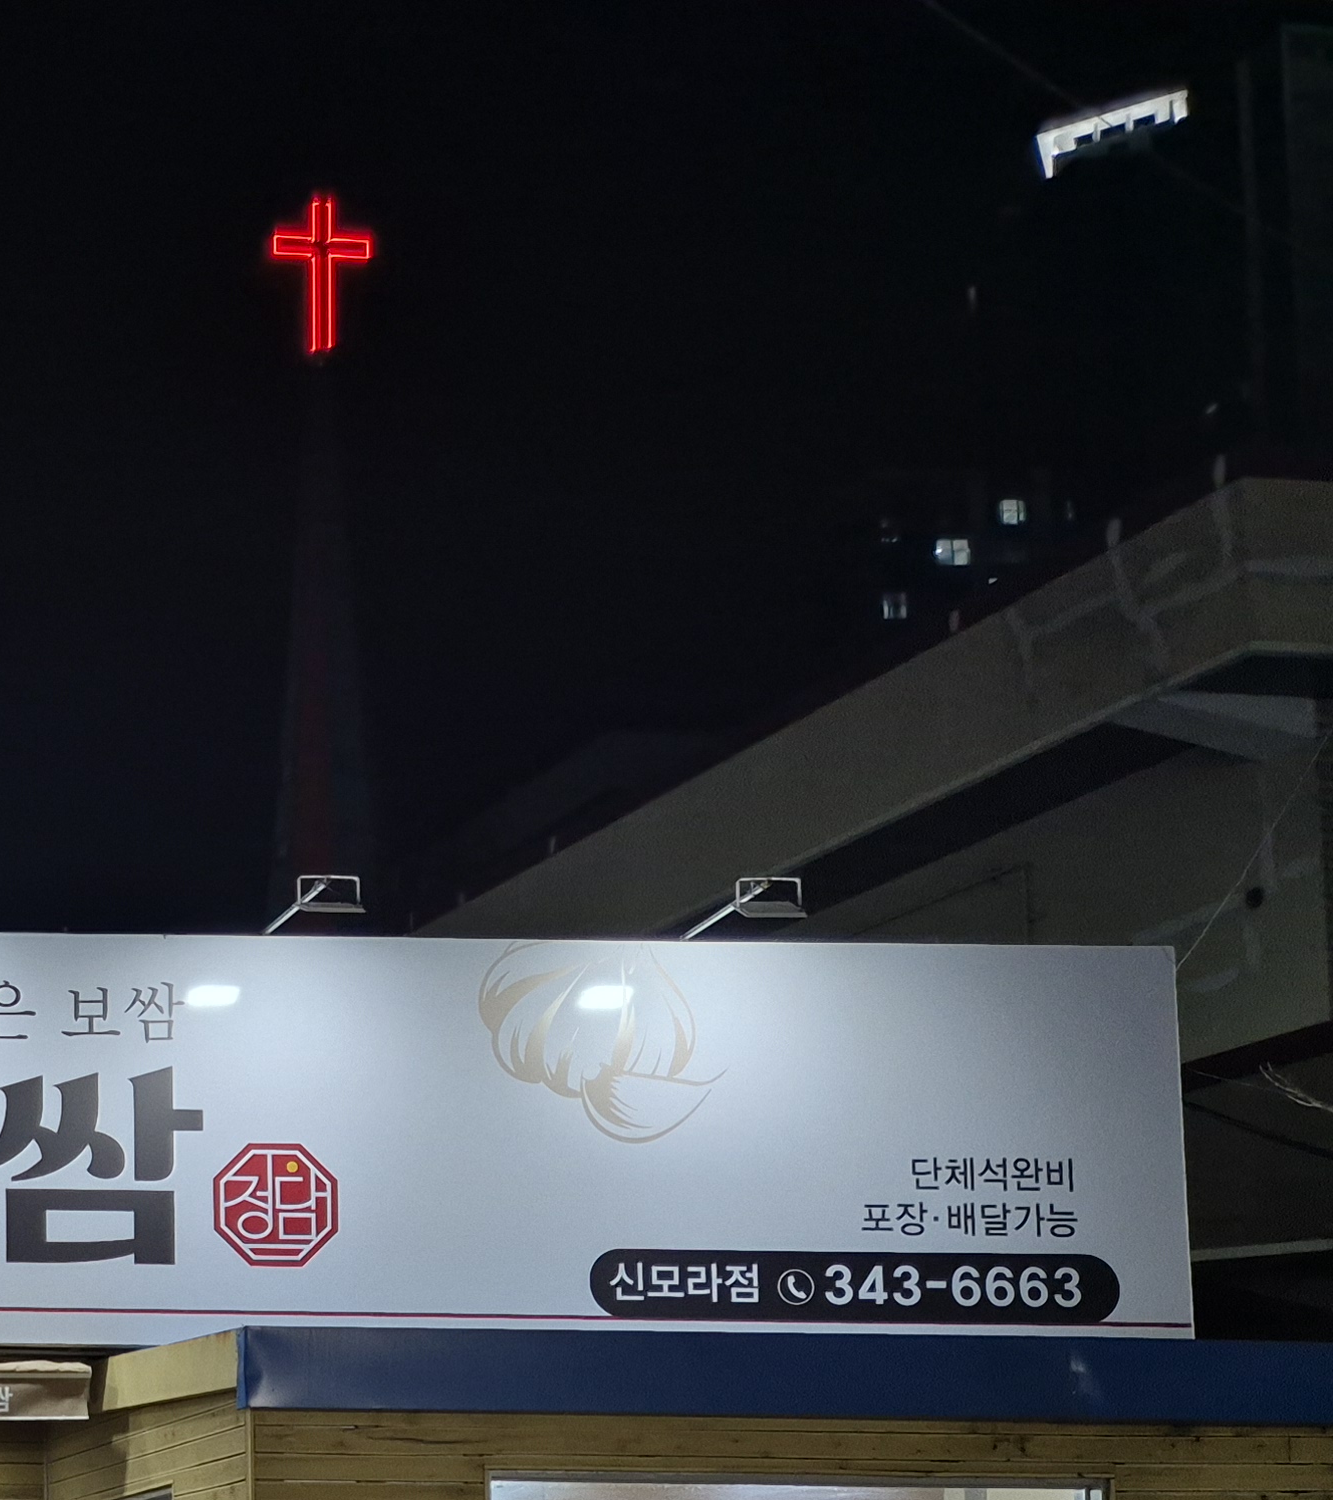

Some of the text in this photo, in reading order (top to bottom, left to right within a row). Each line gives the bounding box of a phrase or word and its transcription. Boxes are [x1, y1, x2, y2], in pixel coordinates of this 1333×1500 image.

[60, 981, 186, 1043] 보쌈
[217, 1150, 331, 1245] 정담
[910, 1156, 1076, 1193] 단체석완비
[608, 1262, 1083, 1308] 신모라점 343-6663
